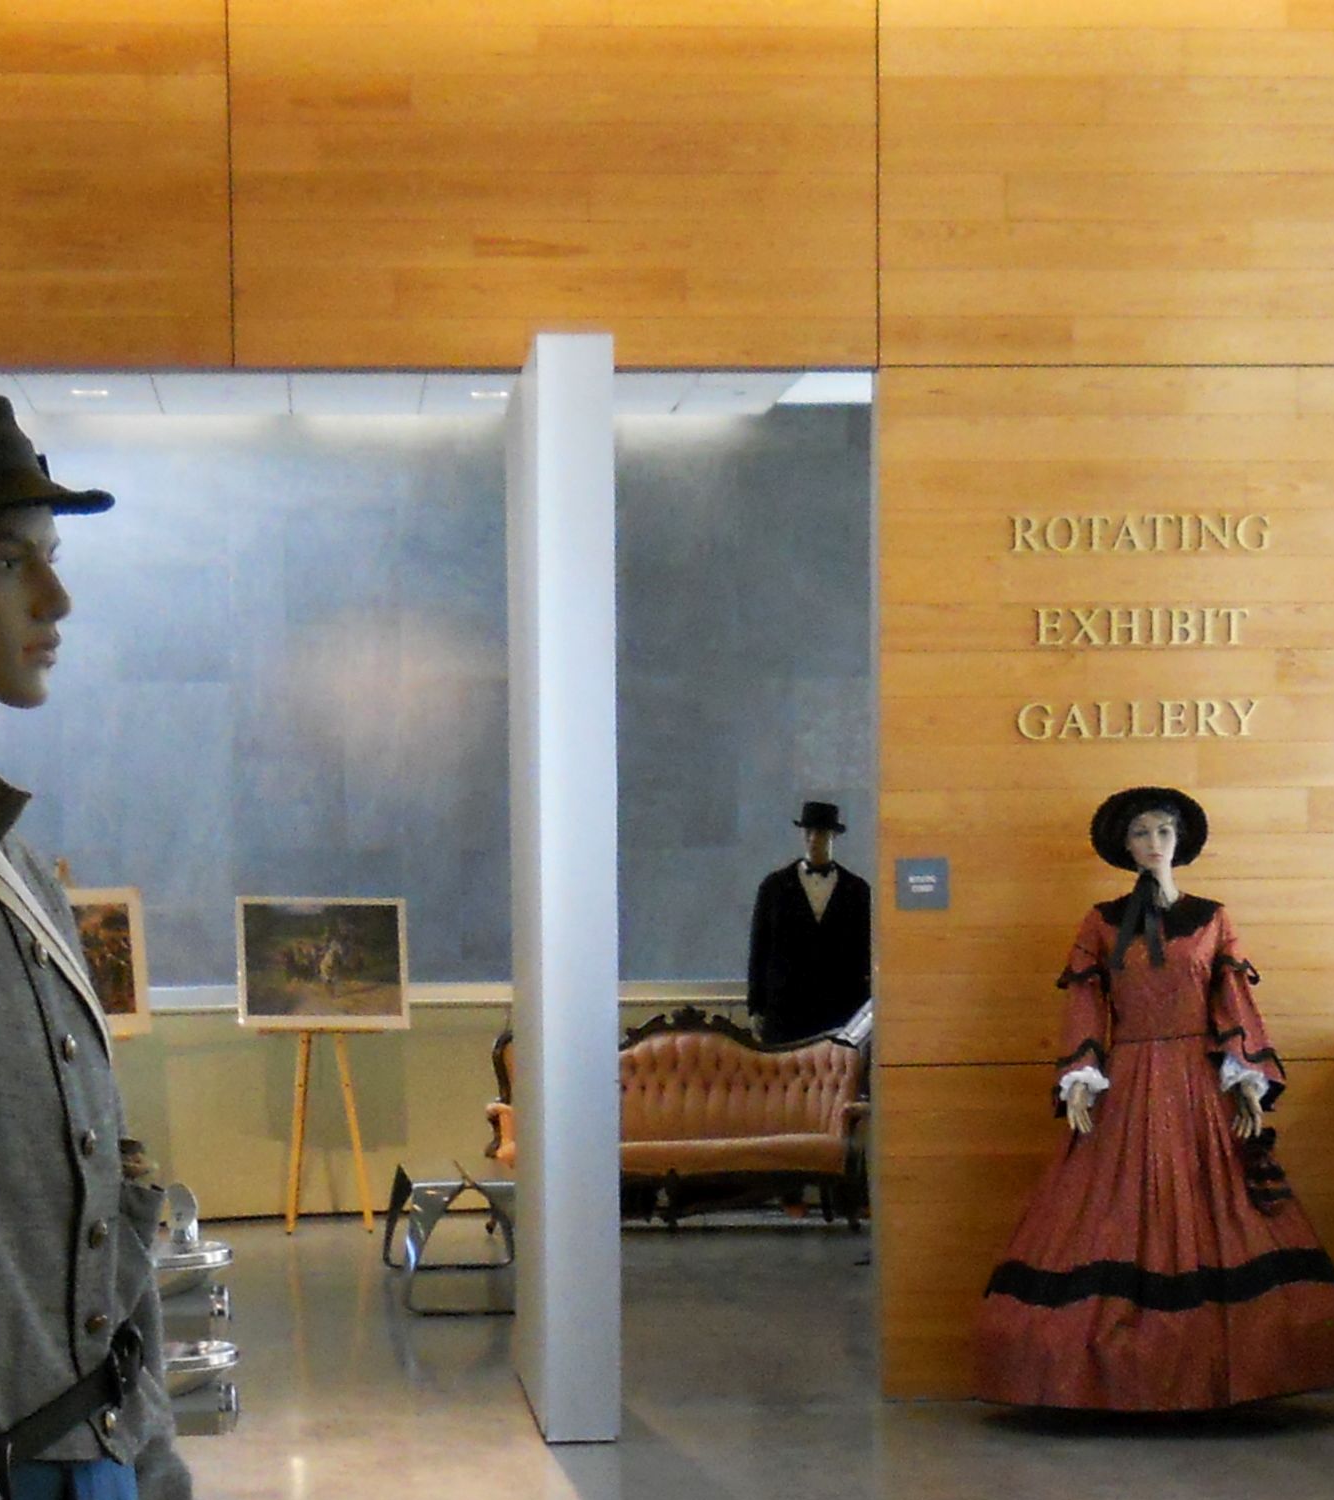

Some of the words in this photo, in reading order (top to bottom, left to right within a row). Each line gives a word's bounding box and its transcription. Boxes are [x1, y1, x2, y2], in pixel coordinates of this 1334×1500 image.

[1008, 513, 1271, 553] ROTATING
[1033, 607, 1248, 647] EXHIBIT
[1016, 698, 1260, 741] GALLERY
